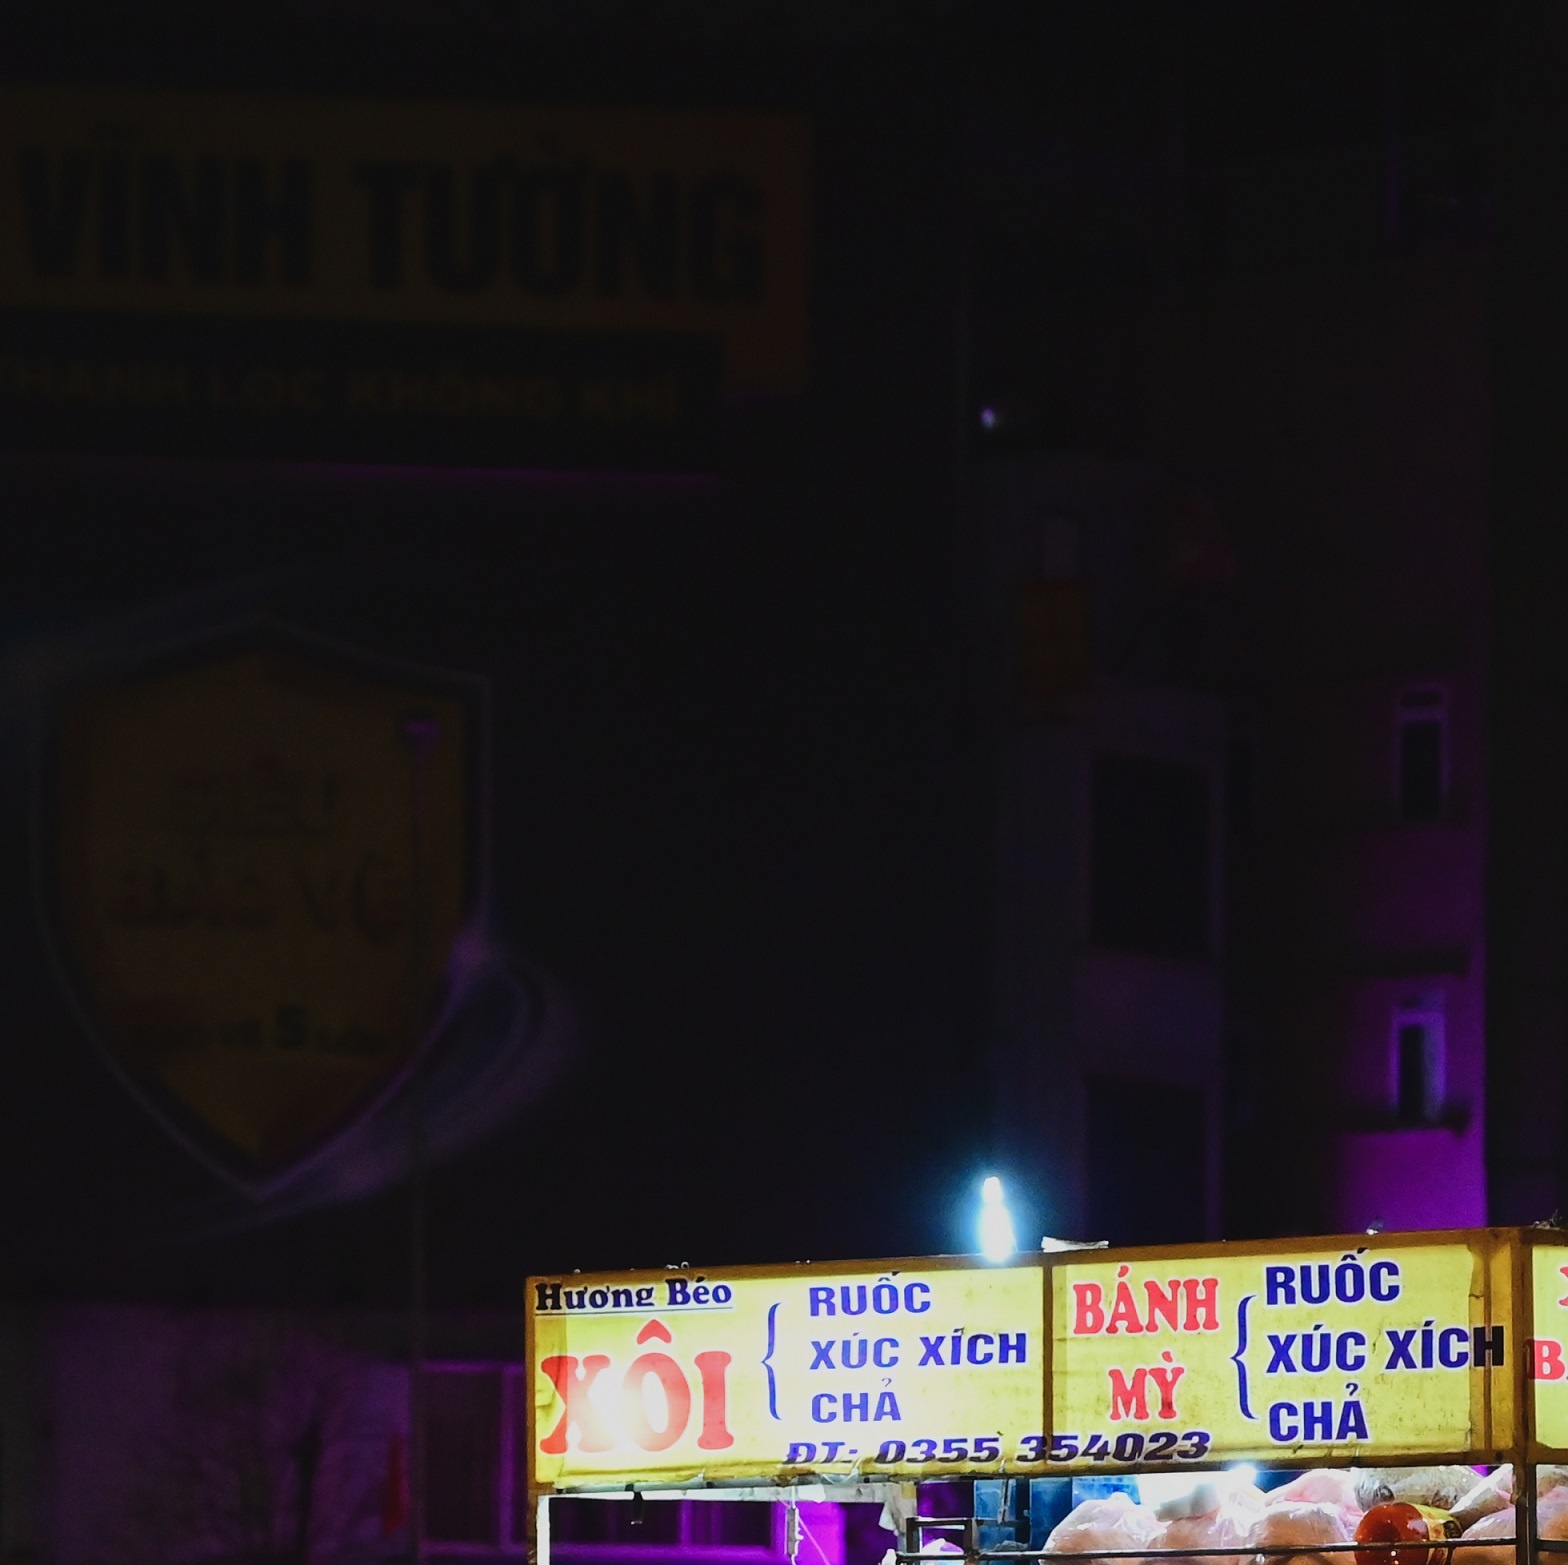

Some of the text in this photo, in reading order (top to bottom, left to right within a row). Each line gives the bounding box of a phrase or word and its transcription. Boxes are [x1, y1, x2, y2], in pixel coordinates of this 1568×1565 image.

[19, 121, 314, 287] VĨNH
[535, 1277, 732, 1310] Hương Béo
[809, 1271, 931, 1318] RUỐC
[1073, 1265, 1220, 1335] BÁNH
[1265, 1246, 1400, 1306] RUỐC
[809, 1327, 1026, 1370] XÚC XÍCH
[1265, 1319, 1505, 1375] XÚC XÍCH
[539, 1318, 734, 1455] XÔI
[811, 1378, 901, 1423] CHẢ
[1108, 1351, 1184, 1422] MỲ
[1269, 1382, 1369, 1443] CHẢ
[874, 1437, 1001, 1464] 0355
[1016, 1430, 1212, 1463] 354023
